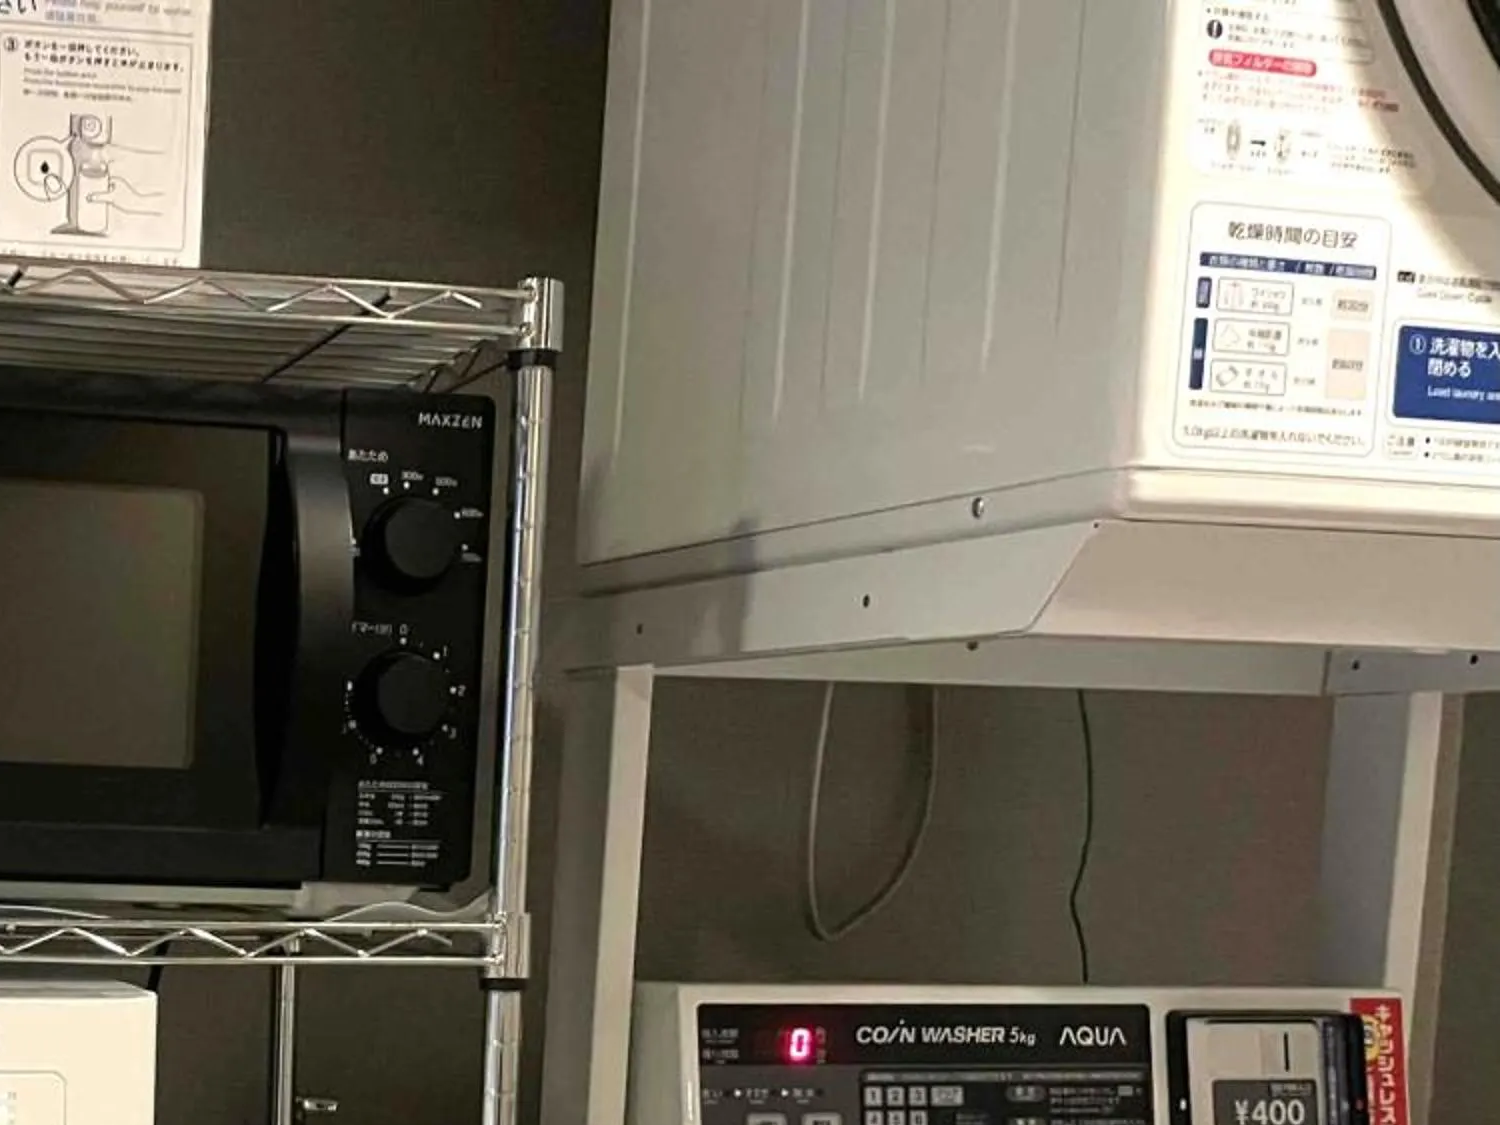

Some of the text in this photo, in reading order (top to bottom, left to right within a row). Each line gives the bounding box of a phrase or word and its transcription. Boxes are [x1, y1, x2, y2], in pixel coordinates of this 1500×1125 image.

[1228, 221, 1359, 249] 乾燥時間の目安
[418, 412, 483, 429] MAXZEN
[790, 1027, 811, 1060] 0
[921, 1026, 1005, 1044] WASHER
[1009, 1028, 1036, 1047] 5kg
[1059, 1025, 1127, 1046] AQUA
